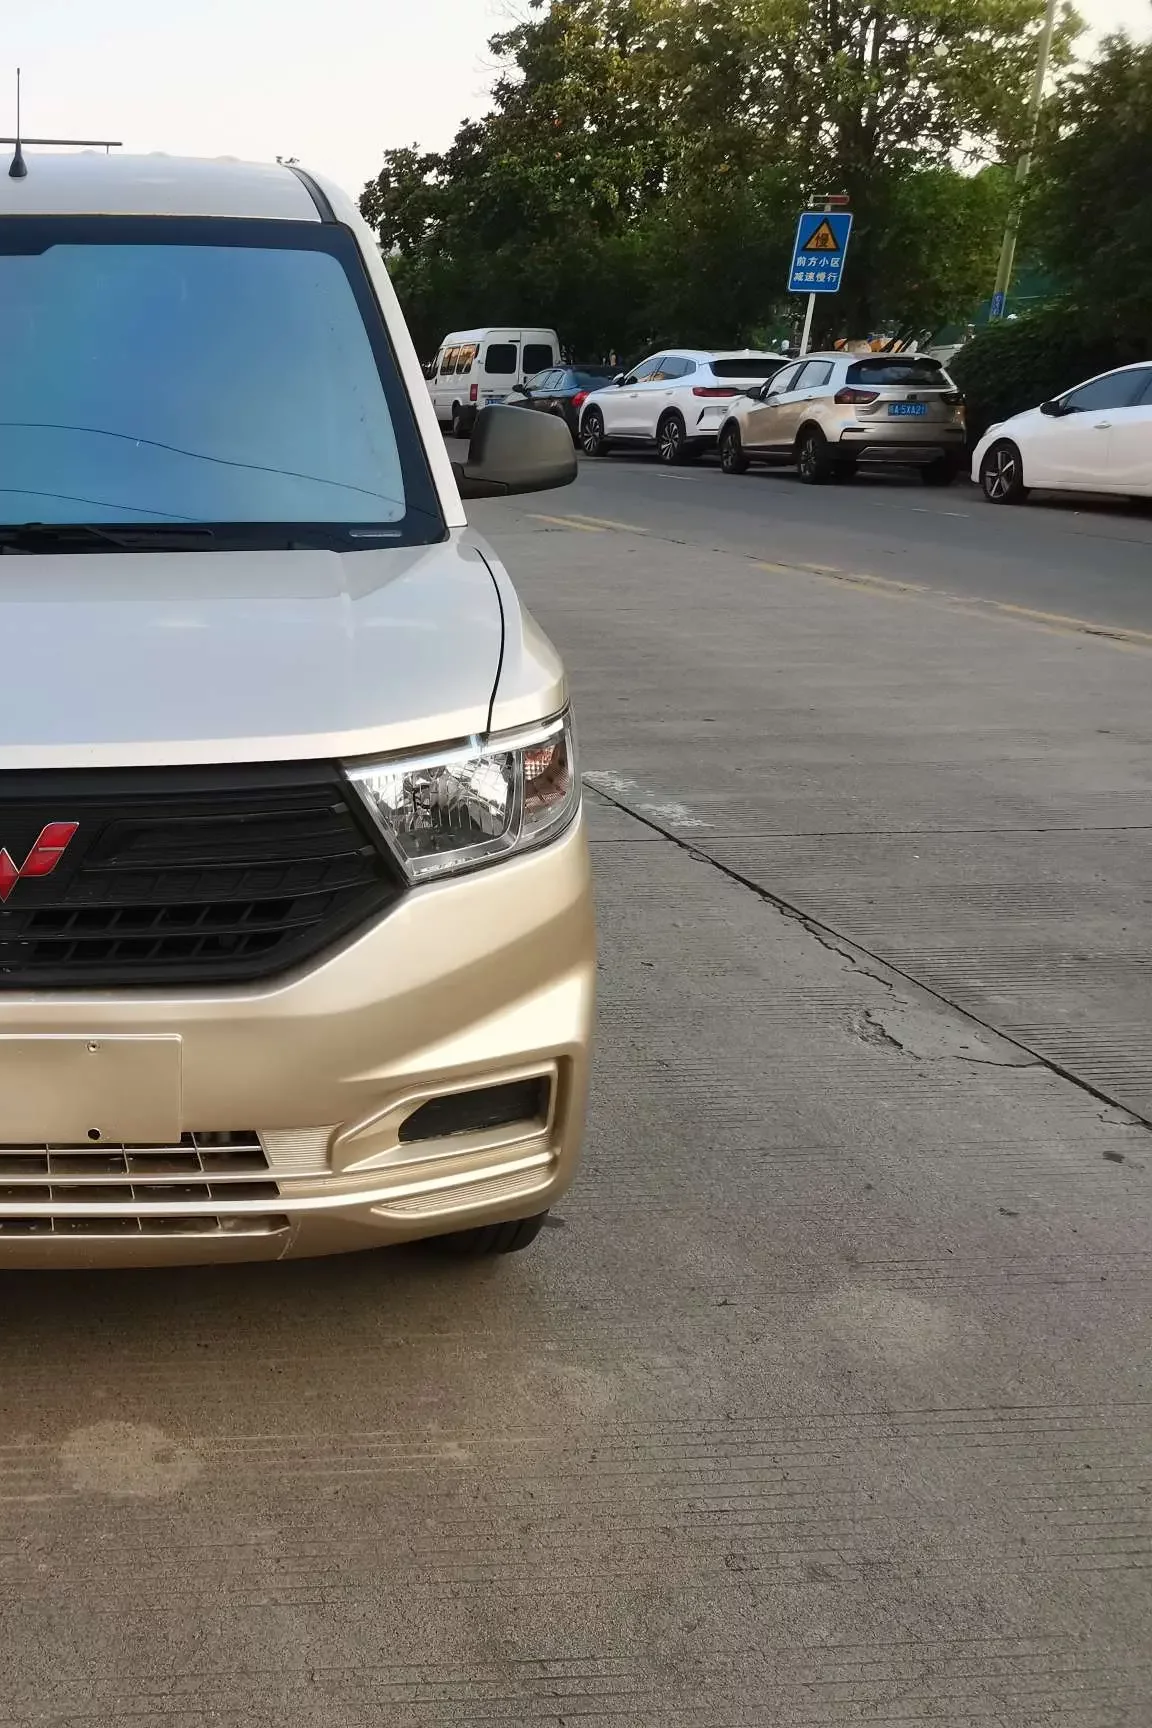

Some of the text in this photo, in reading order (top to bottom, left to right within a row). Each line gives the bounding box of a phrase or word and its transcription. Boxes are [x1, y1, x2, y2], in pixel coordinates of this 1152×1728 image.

[796, 256, 841, 268] 前方小区
[793, 272, 839, 283] 减速慢行
